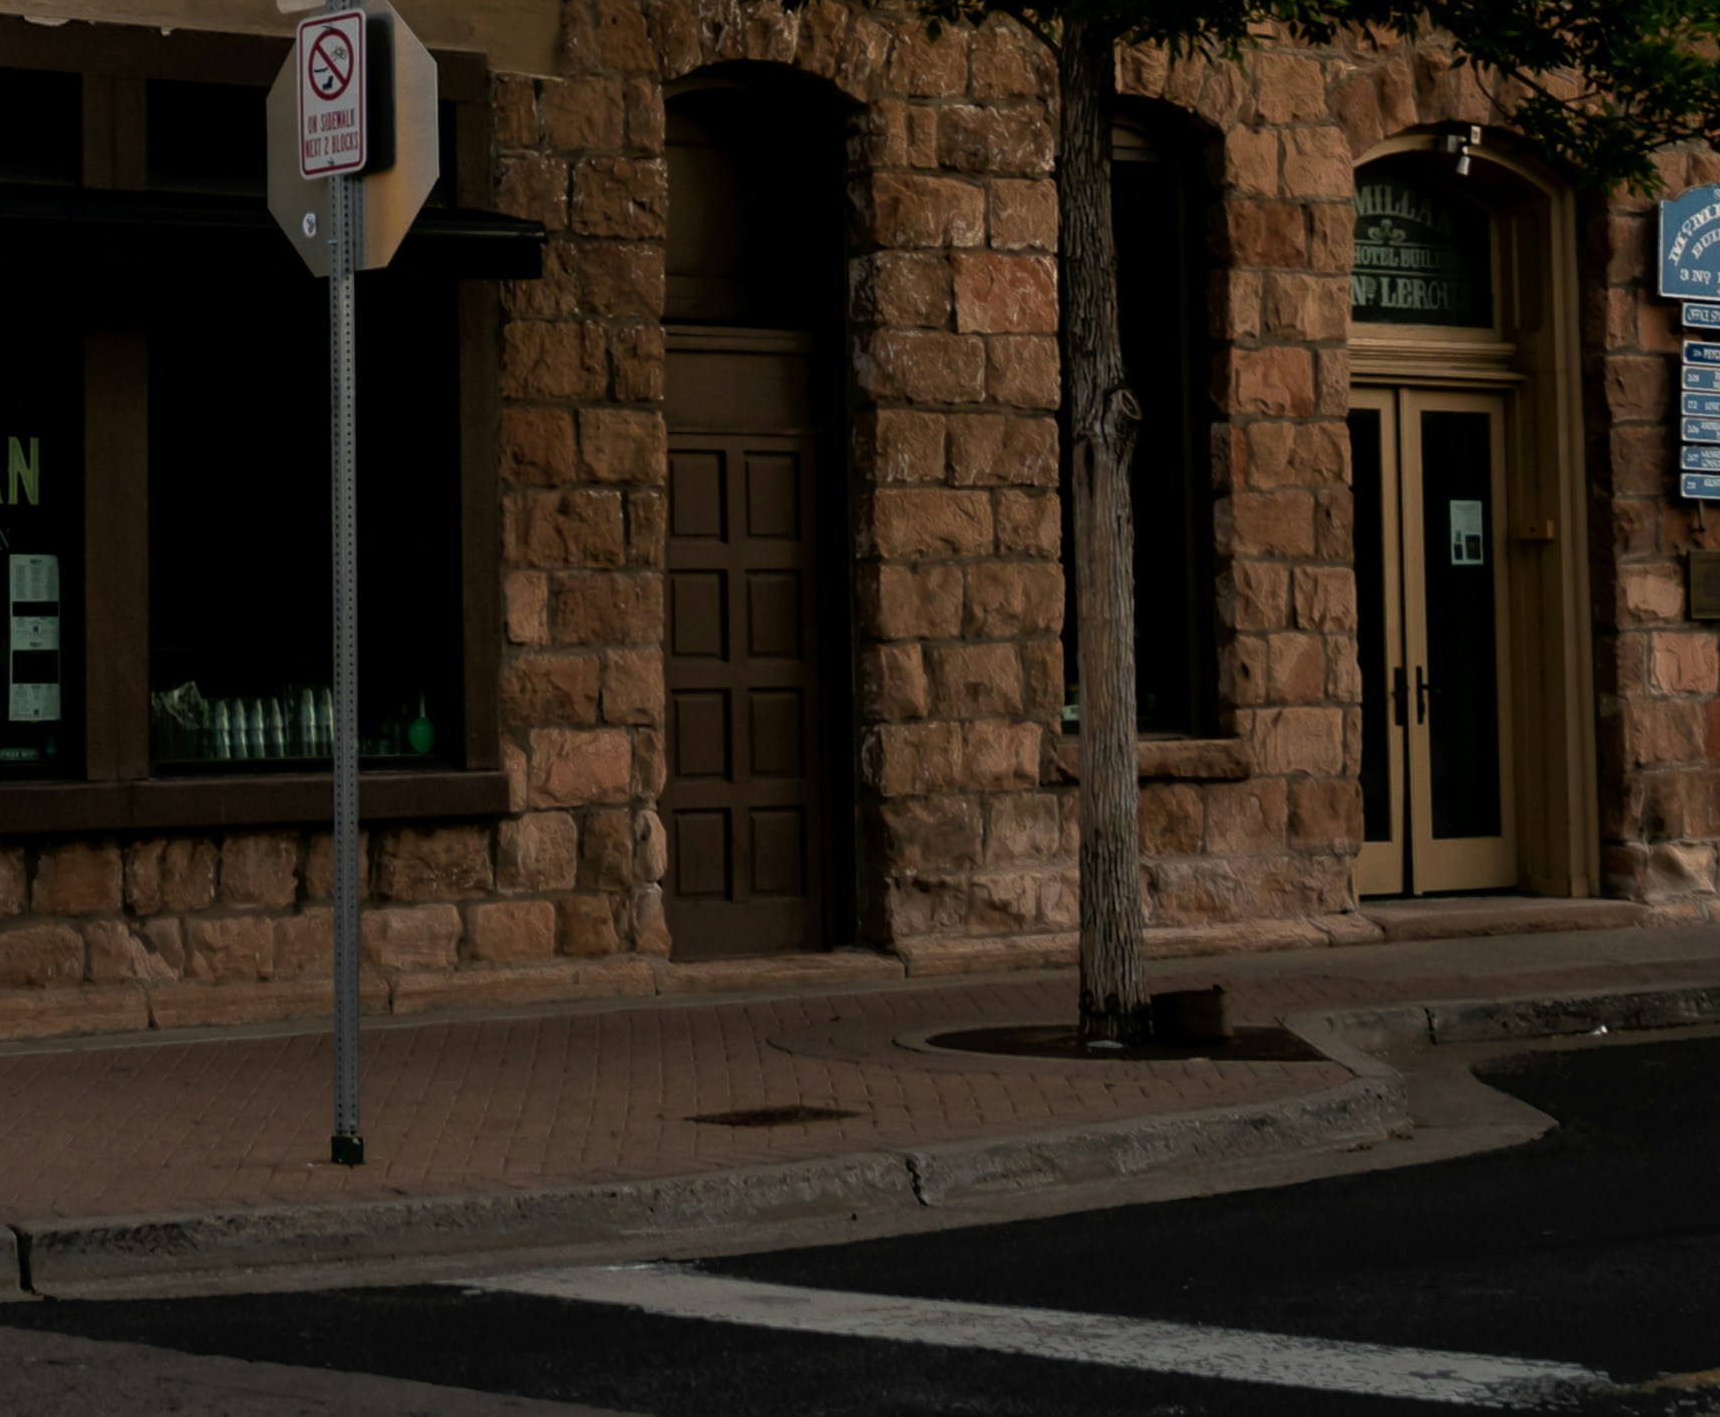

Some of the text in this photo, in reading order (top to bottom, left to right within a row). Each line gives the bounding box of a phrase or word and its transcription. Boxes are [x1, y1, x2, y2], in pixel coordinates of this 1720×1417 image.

[307, 108, 356, 134] ON SIDEWALK
[305, 131, 359, 158] NEXT 2 BLOCKS
[1680, 268, 1690, 281] 3
[1687, 308, 1709, 322] OFFICE
